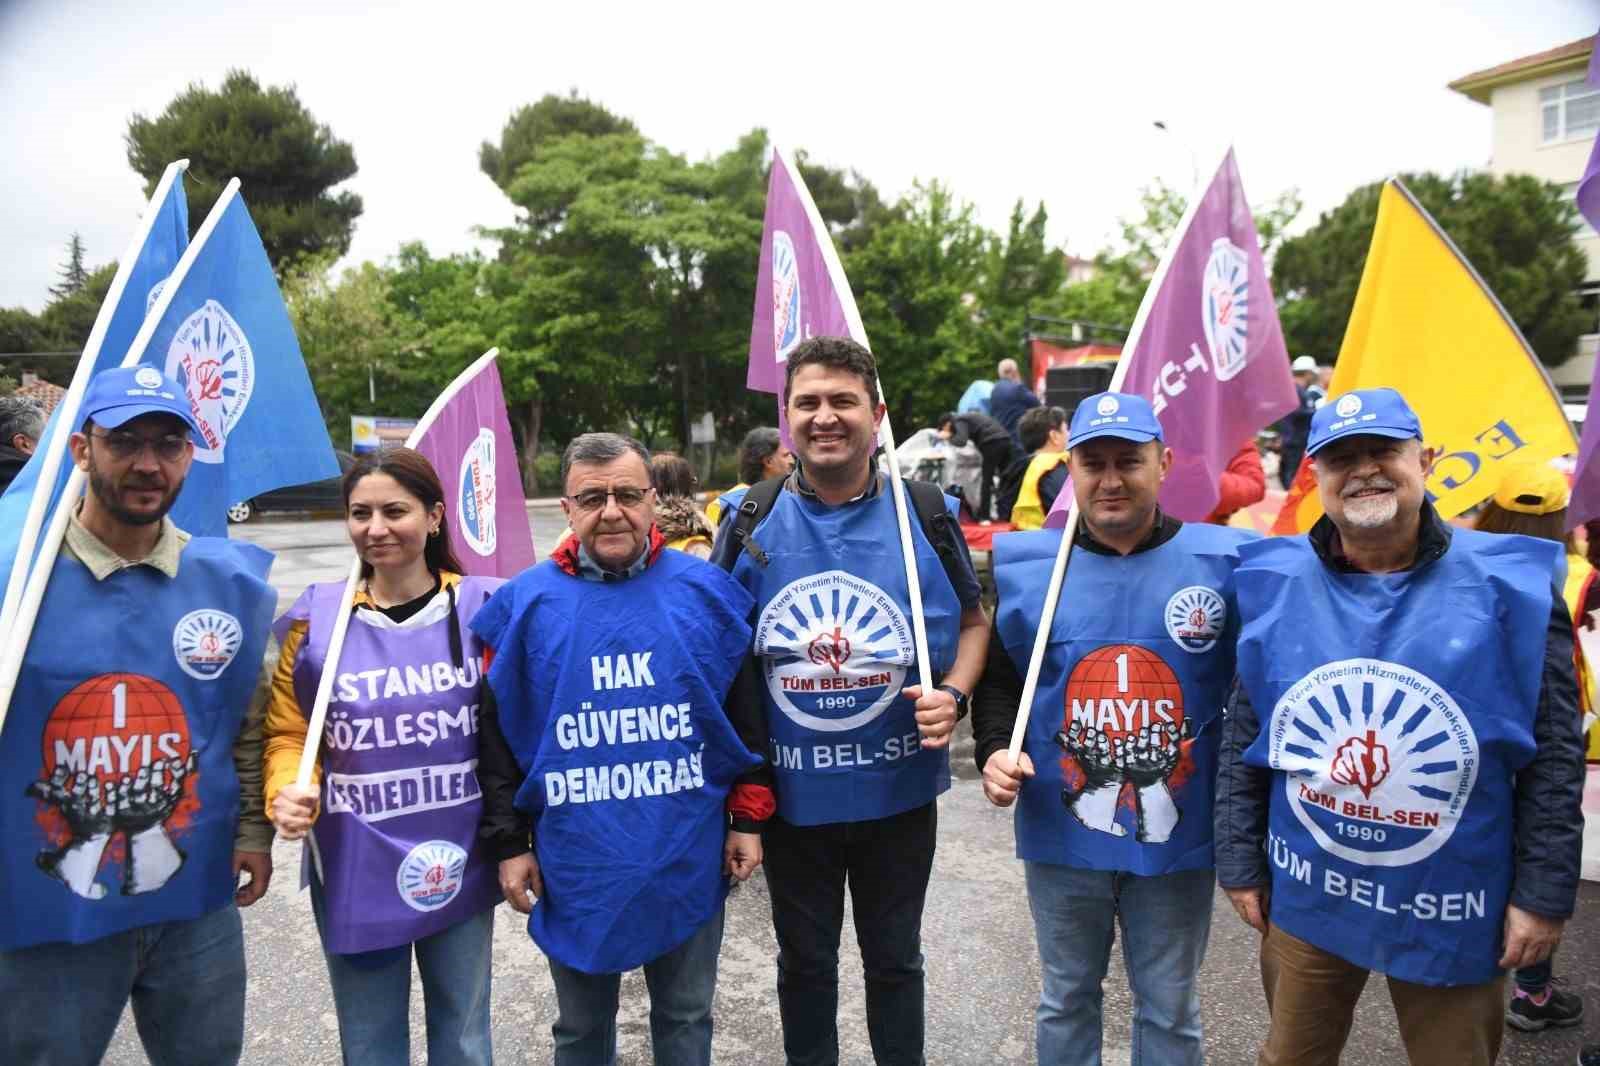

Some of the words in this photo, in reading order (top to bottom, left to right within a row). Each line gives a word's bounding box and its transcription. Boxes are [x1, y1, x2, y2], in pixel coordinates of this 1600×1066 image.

[792, 577, 831, 594] Yönetim
[330, 657, 482, 702] STANBU
[591, 652, 655, 690] HAK
[780, 675, 815, 691] TÜM
[820, 671, 892, 691] BEL-SEN
[1115, 653, 1129, 693] 1
[111, 683, 127, 729] 1
[816, 696, 856, 711] 1990
[1072, 698, 1175, 732] MAYIS
[1314, 665, 1362, 684] Yönetim
[1366, 664, 1431, 696] Hizmetleri
[1430, 692, 1472, 755] Emekçileri
[556, 702, 693, 750] GÜVENCE
[54, 732, 181, 774] MAYIS
[813, 732, 922, 769] BEL-SE
[1299, 783, 1336, 811] TÜM
[1343, 801, 1440, 828] BEL-SEN
[1335, 821, 1387, 843] 1990
[1324, 867, 1486, 922] BEL-SEN
